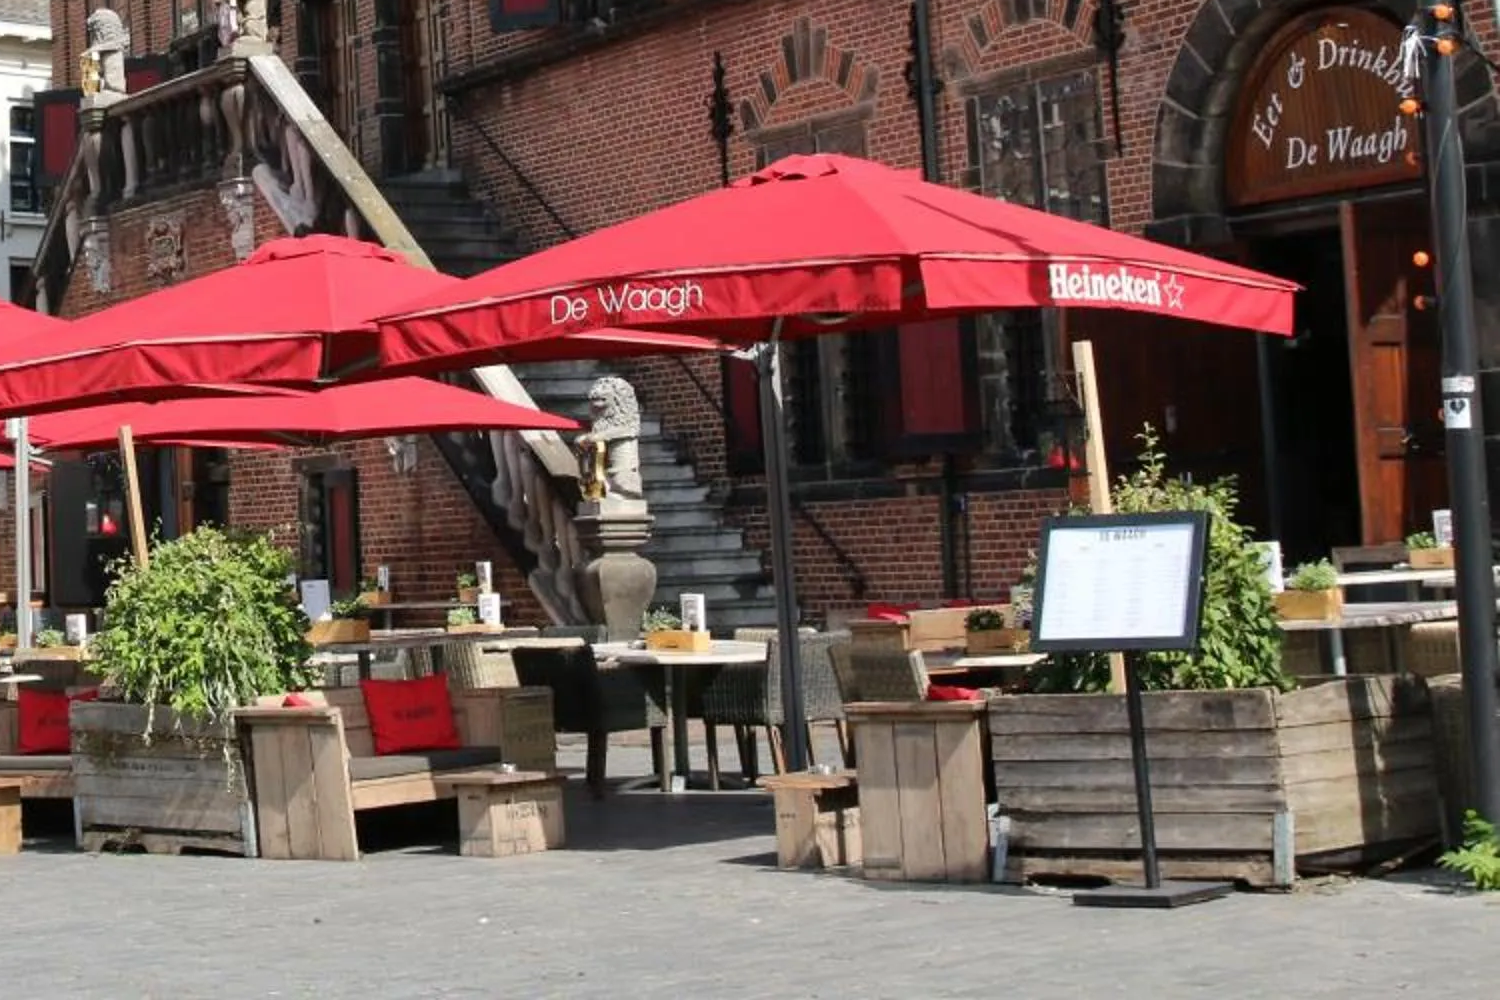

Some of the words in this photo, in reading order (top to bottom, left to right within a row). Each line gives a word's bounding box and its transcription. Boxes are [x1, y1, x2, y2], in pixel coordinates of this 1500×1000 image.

[1285, 136, 1318, 170] De
[1325, 115, 1408, 163] Waagh
[550, 295, 588, 325] De
[597, 279, 704, 317] Waagh
[1048, 263, 1163, 307] Heineken
